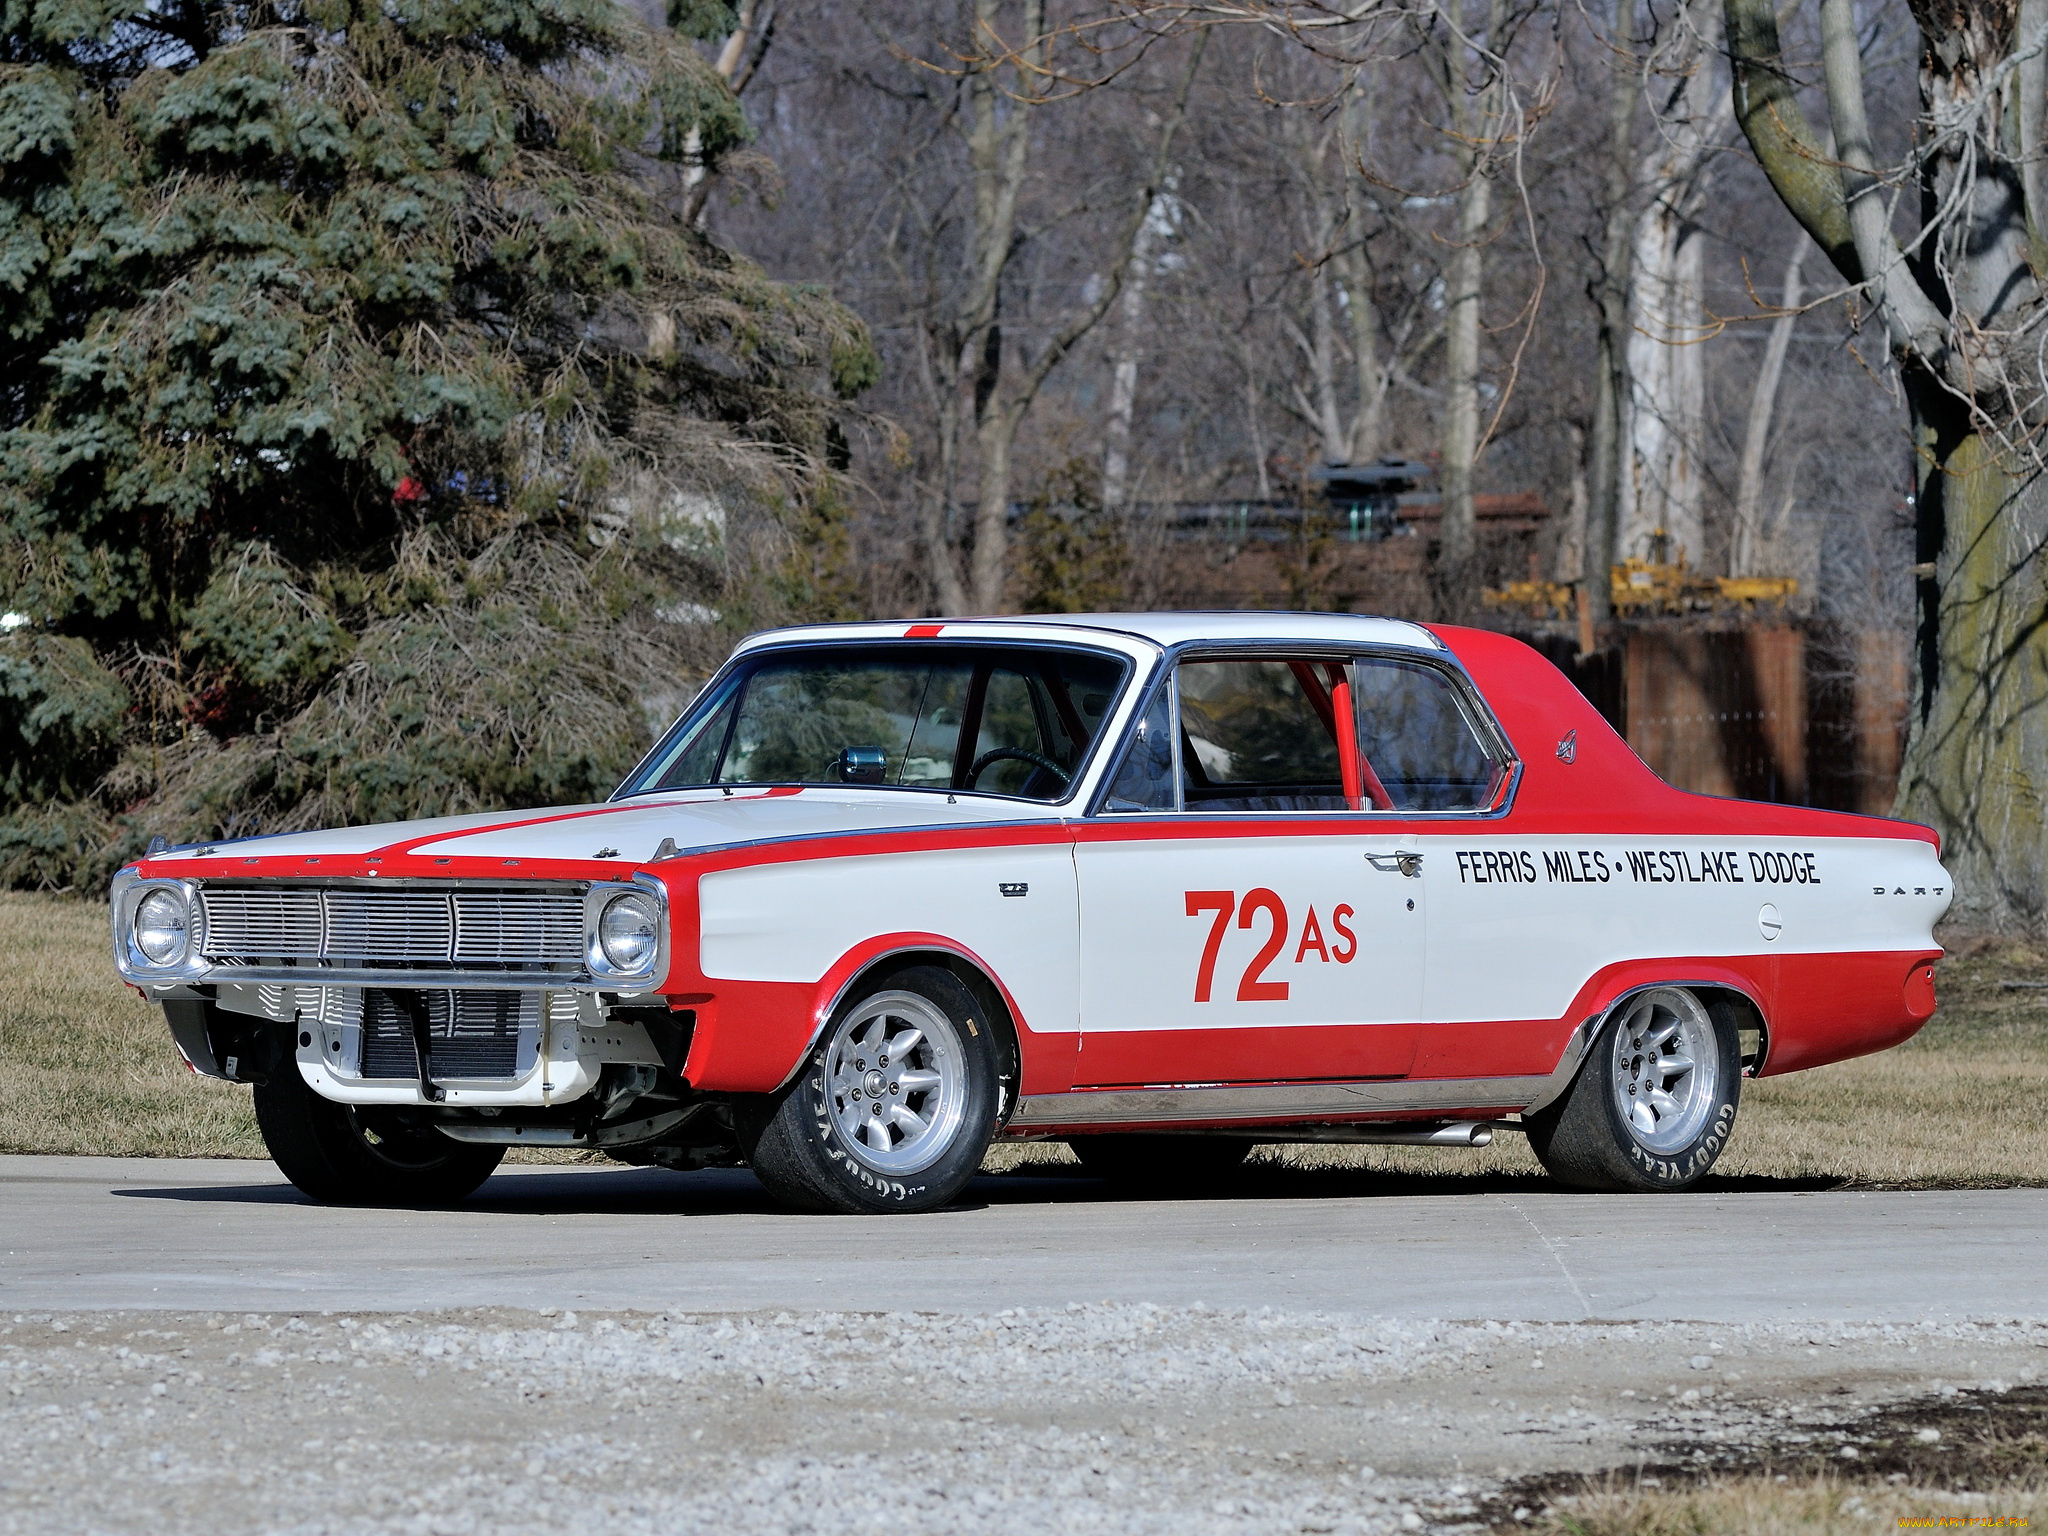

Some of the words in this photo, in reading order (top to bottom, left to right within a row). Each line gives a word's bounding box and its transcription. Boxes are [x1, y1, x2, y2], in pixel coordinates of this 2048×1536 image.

[1455, 850, 1537, 883] FERRIS
[1543, 850, 1611, 883] MILES
[1624, 850, 1744, 883] WESTLAKE
[1747, 851, 1821, 884] DODGE
[1872, 886, 1945, 896] DART
[1630, 1103, 1735, 1181] GOODYEAR
